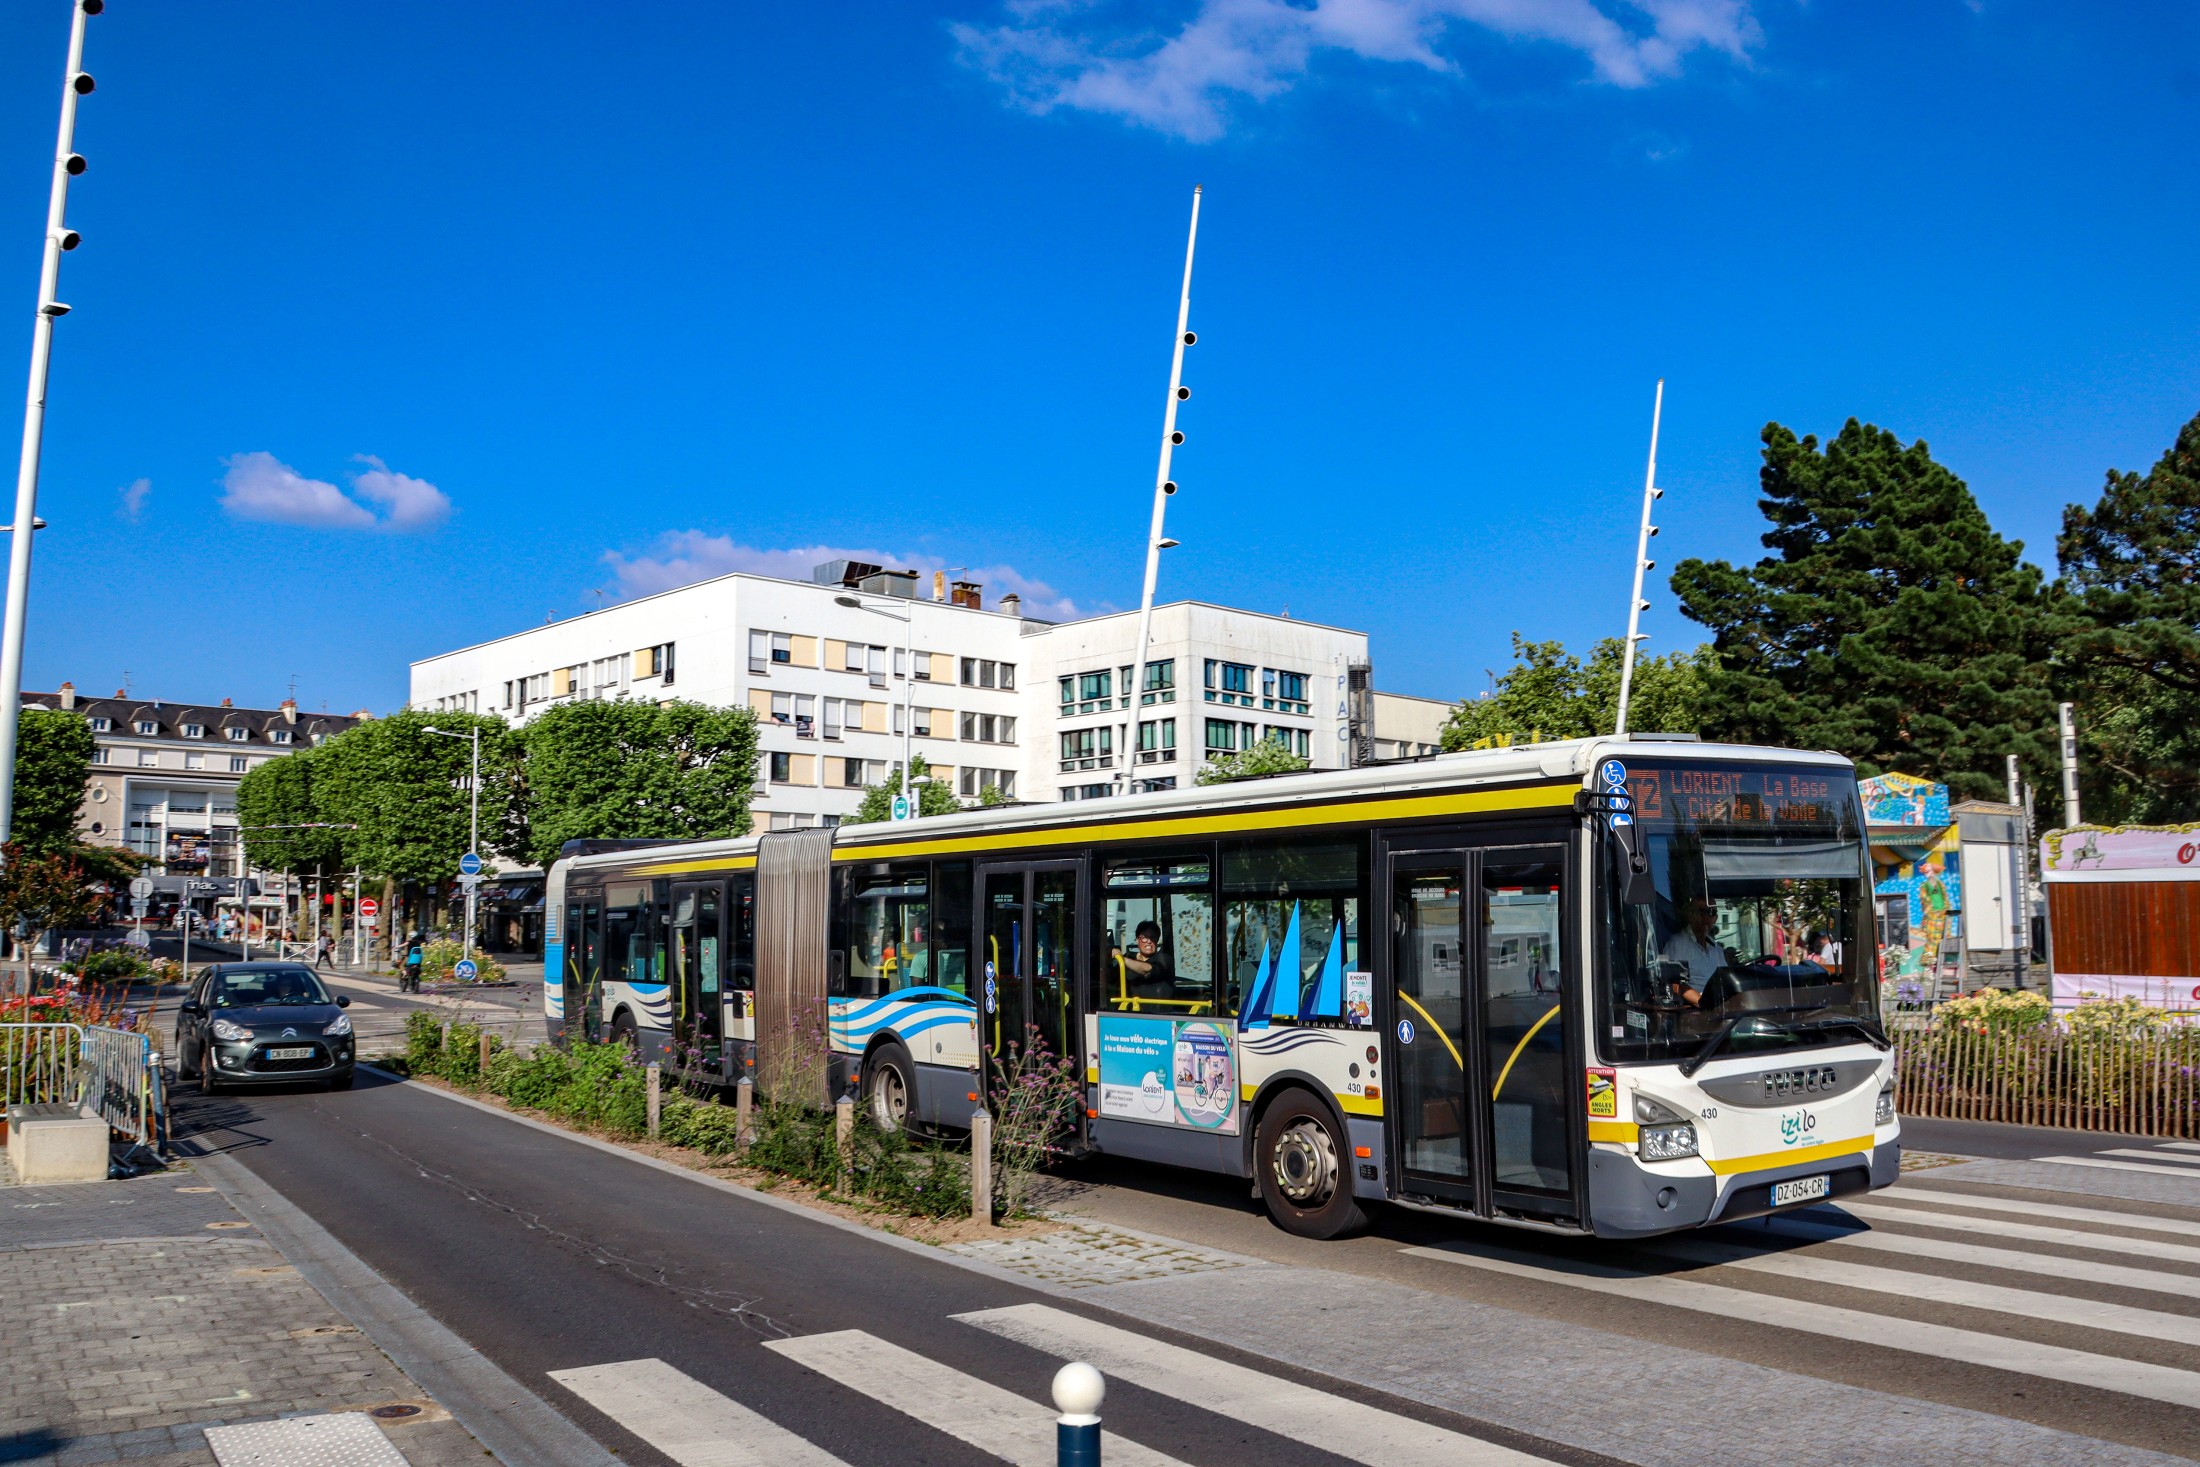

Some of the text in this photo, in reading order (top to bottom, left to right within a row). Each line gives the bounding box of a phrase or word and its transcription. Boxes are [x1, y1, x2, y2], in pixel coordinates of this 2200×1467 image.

[1670, 770, 1828, 797] LORIENT La Base
[1731, 798, 1750, 819] de
[187, 880, 218, 890] fnac
[1130, 1033, 1143, 1044] vélo
[1144, 1037, 1168, 1046] électrique
[1117, 1045, 1135, 1053] Maison
[1136, 1046, 1143, 1054] du
[1144, 1046, 1155, 1055] vélo
[1347, 1083, 1361, 1093] 430
[1763, 1067, 1836, 1098] IVECO
[1701, 1108, 1718, 1119] 430
[1781, 1108, 1816, 1137] izilo
